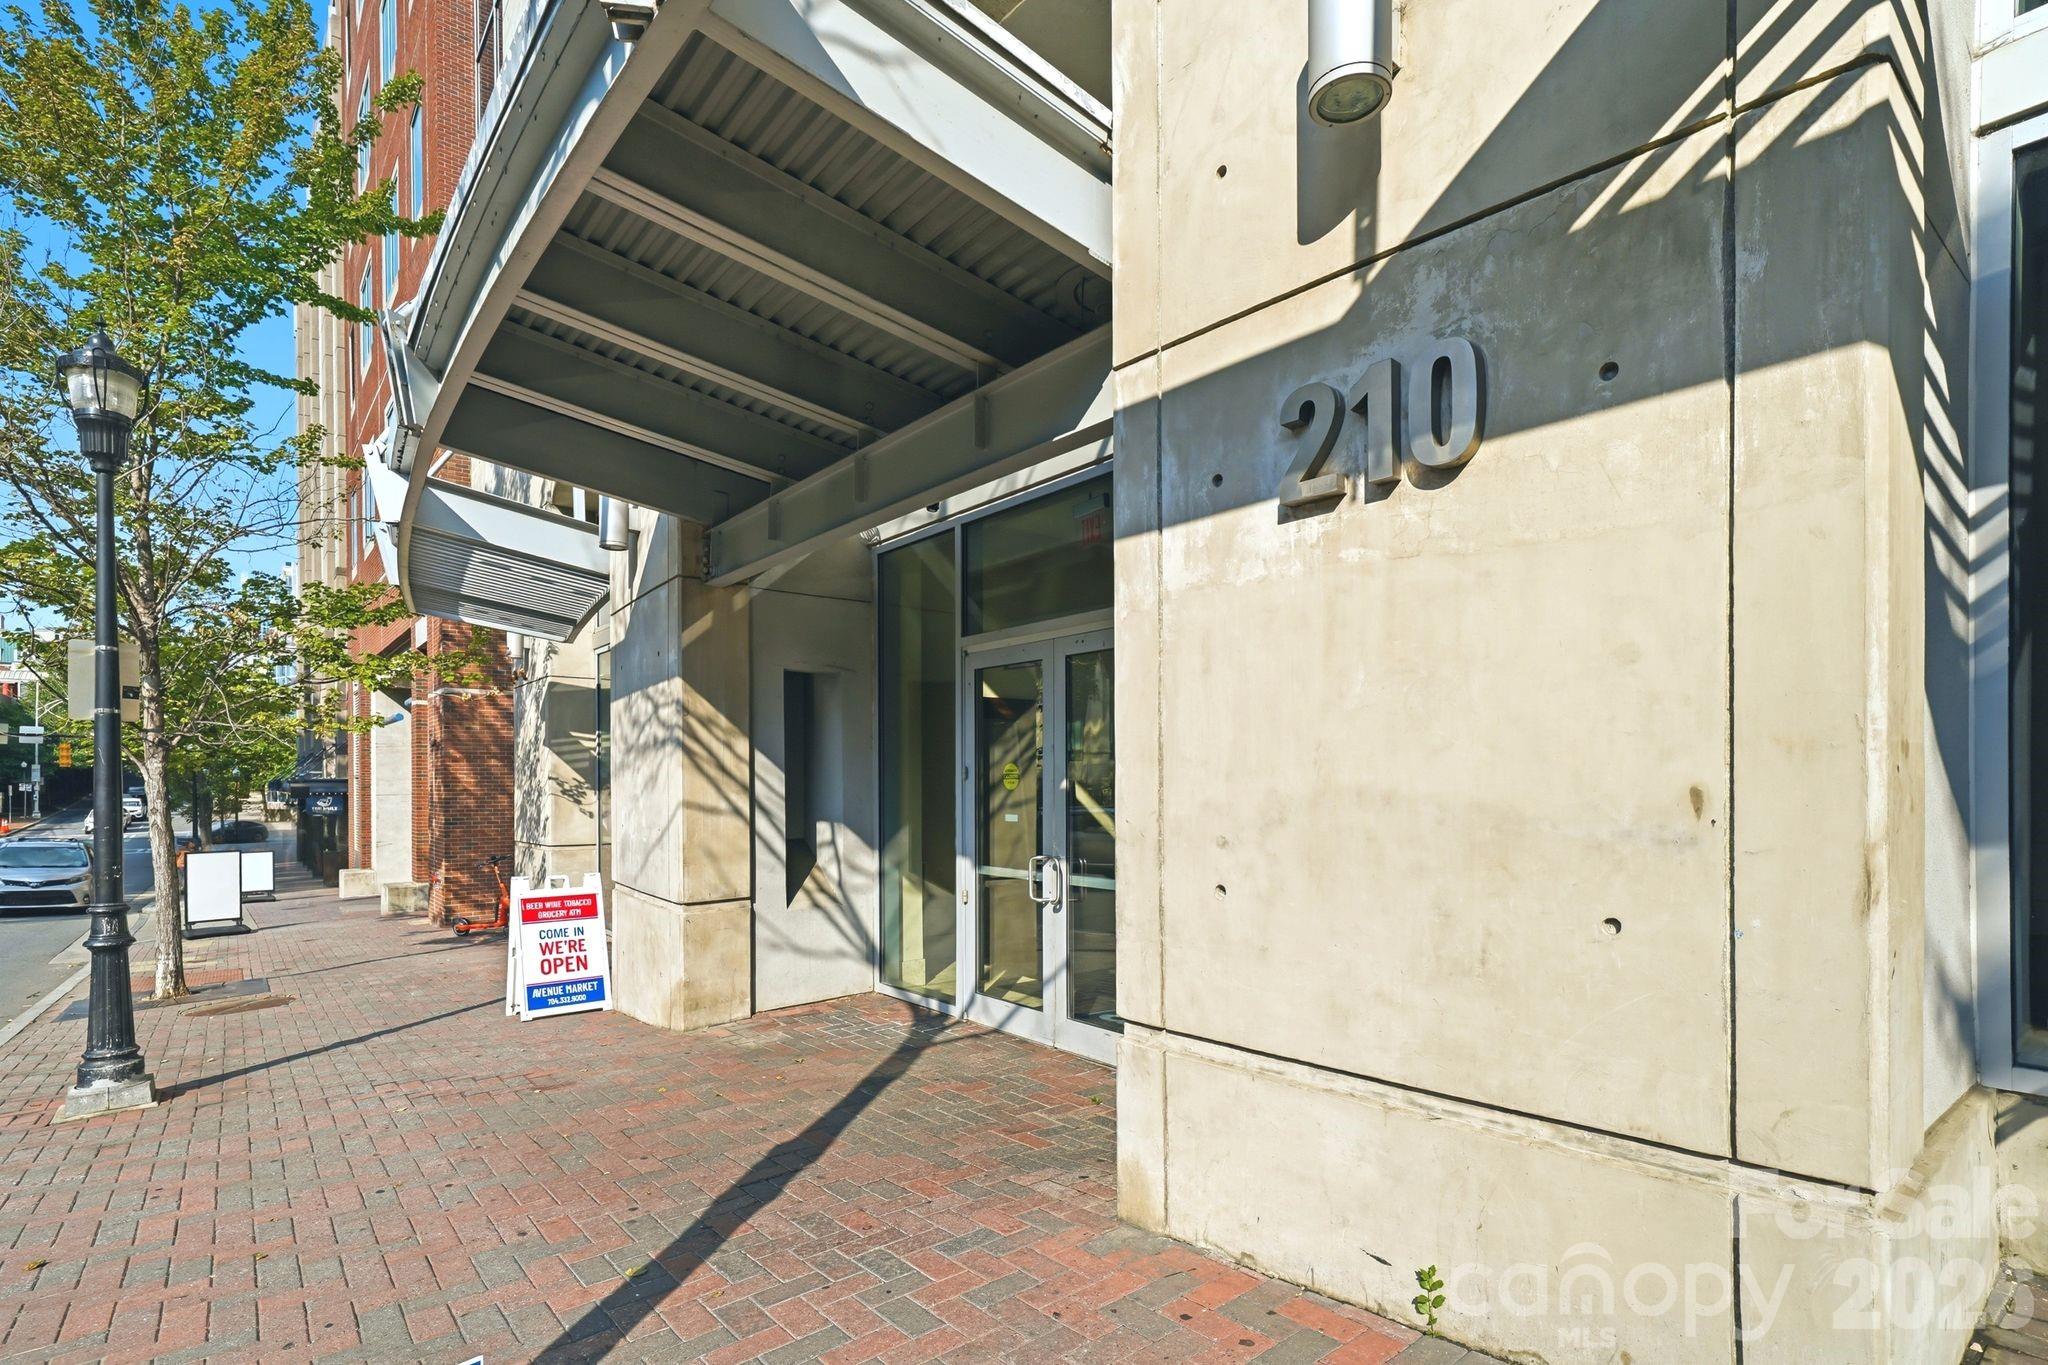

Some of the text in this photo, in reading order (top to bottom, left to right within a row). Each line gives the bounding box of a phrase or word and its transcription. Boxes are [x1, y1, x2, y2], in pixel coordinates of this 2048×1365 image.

[1279, 336, 1488, 507] 210
[545, 900, 562, 908] WINE
[564, 899, 592, 907] TOBACCO
[538, 910, 567, 919] GROCERY
[539, 926, 584, 940] COME IN
[539, 938, 586, 956] WE'RE
[540, 955, 588, 975] OPEN
[532, 981, 598, 998] AVENUE MARKET
